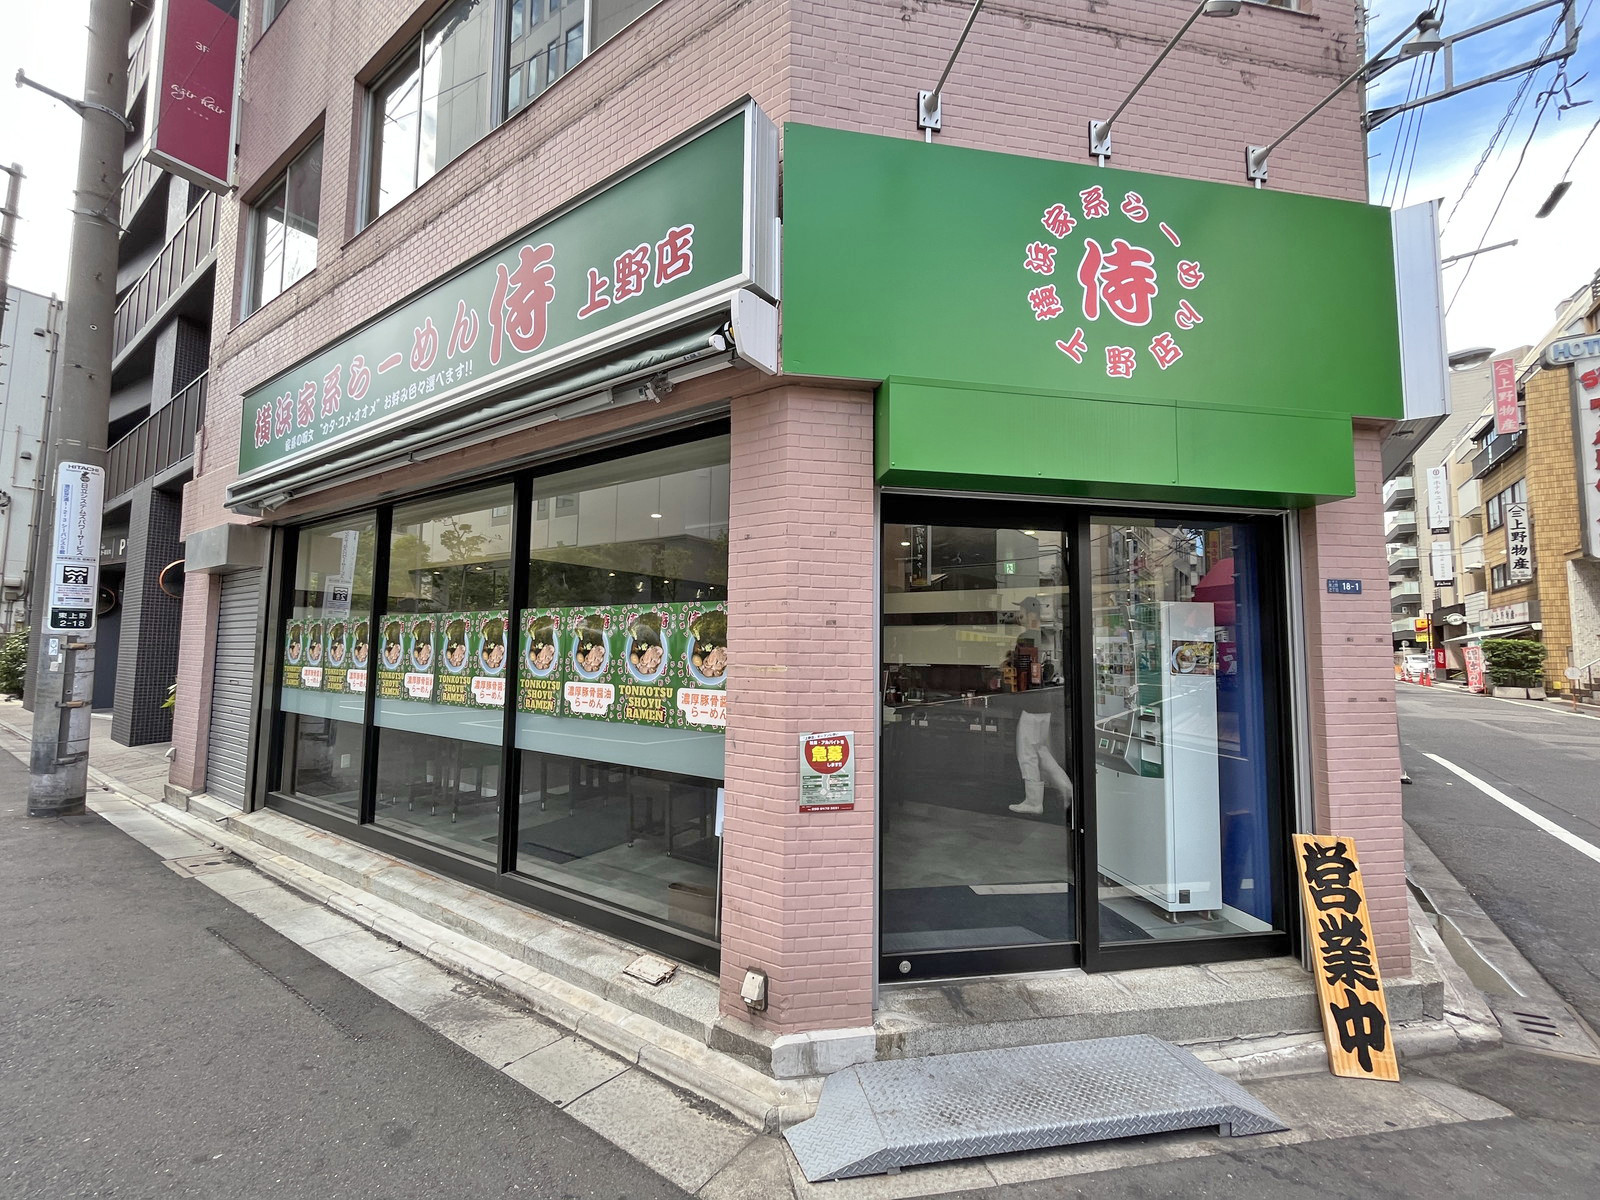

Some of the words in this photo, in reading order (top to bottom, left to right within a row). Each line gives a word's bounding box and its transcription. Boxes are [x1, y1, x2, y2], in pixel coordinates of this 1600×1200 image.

[577, 223, 696, 321] 上野店
[1077, 237, 1159, 327] 侍
[1497, 378, 1517, 431] 上野物産
[67, 464, 100, 472] HITACHI
[76, 483, 88, 556] 日立システムズパワーサービス
[1510, 518, 1530, 570] 上野物産
[1342, 582, 1359, 591] 18-1
[58, 612, 88, 620] 東上野
[438, 675, 471, 684] TONKOTSU
[520, 679, 561, 690] TONKOTSU
[444, 684, 465, 692] SHOYU
[567, 686, 612, 699] 濃厚豚骨醤油
[618, 685, 673, 698] TONKOTSU
[443, 692, 465, 702] RAMEN
[480, 691, 502, 700] らーめん
[527, 690, 553, 699] SHOYU
[525, 699, 553, 709] RAMEN
[574, 697, 604, 709] らーめん
[628, 697, 662, 709] SHOYU
[625, 707, 664, 720] RAMEN
[691, 706, 727, 720] らーめん
[1303, 841, 1387, 1073] 営業中
